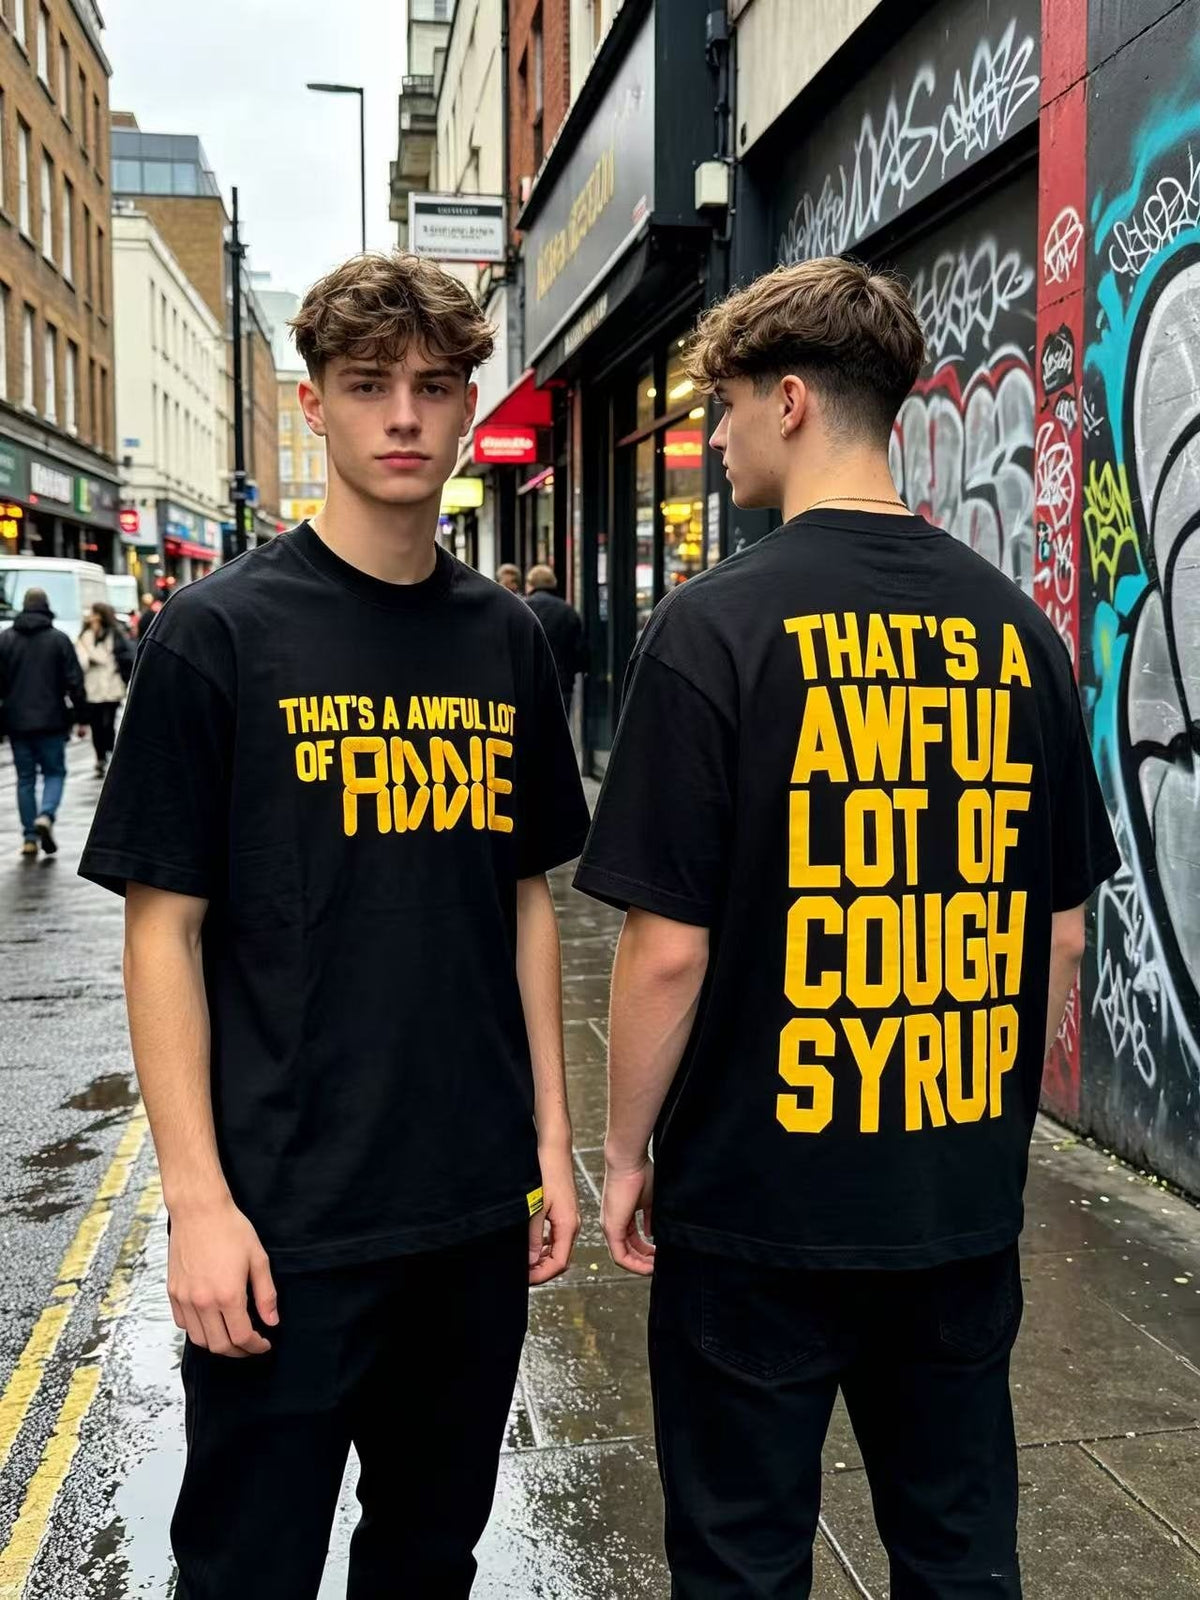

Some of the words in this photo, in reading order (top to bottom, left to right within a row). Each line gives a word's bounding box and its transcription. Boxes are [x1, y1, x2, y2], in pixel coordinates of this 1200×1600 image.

[783, 612, 979, 681] THAT'S
[1000, 623, 1032, 688] A
[279, 695, 376, 734] THAT'S
[382, 696, 400, 730] A
[407, 696, 486, 730] AWFUL
[489, 700, 516, 736] LOT
[295, 739, 335, 782] OF
[790, 685, 1033, 784] AWFUL
[788, 788, 929, 888] LOT
[958, 788, 1031, 884] OF
[784, 891, 1028, 1009] COUGH
[776, 1003, 1019, 1134] SYRUP
